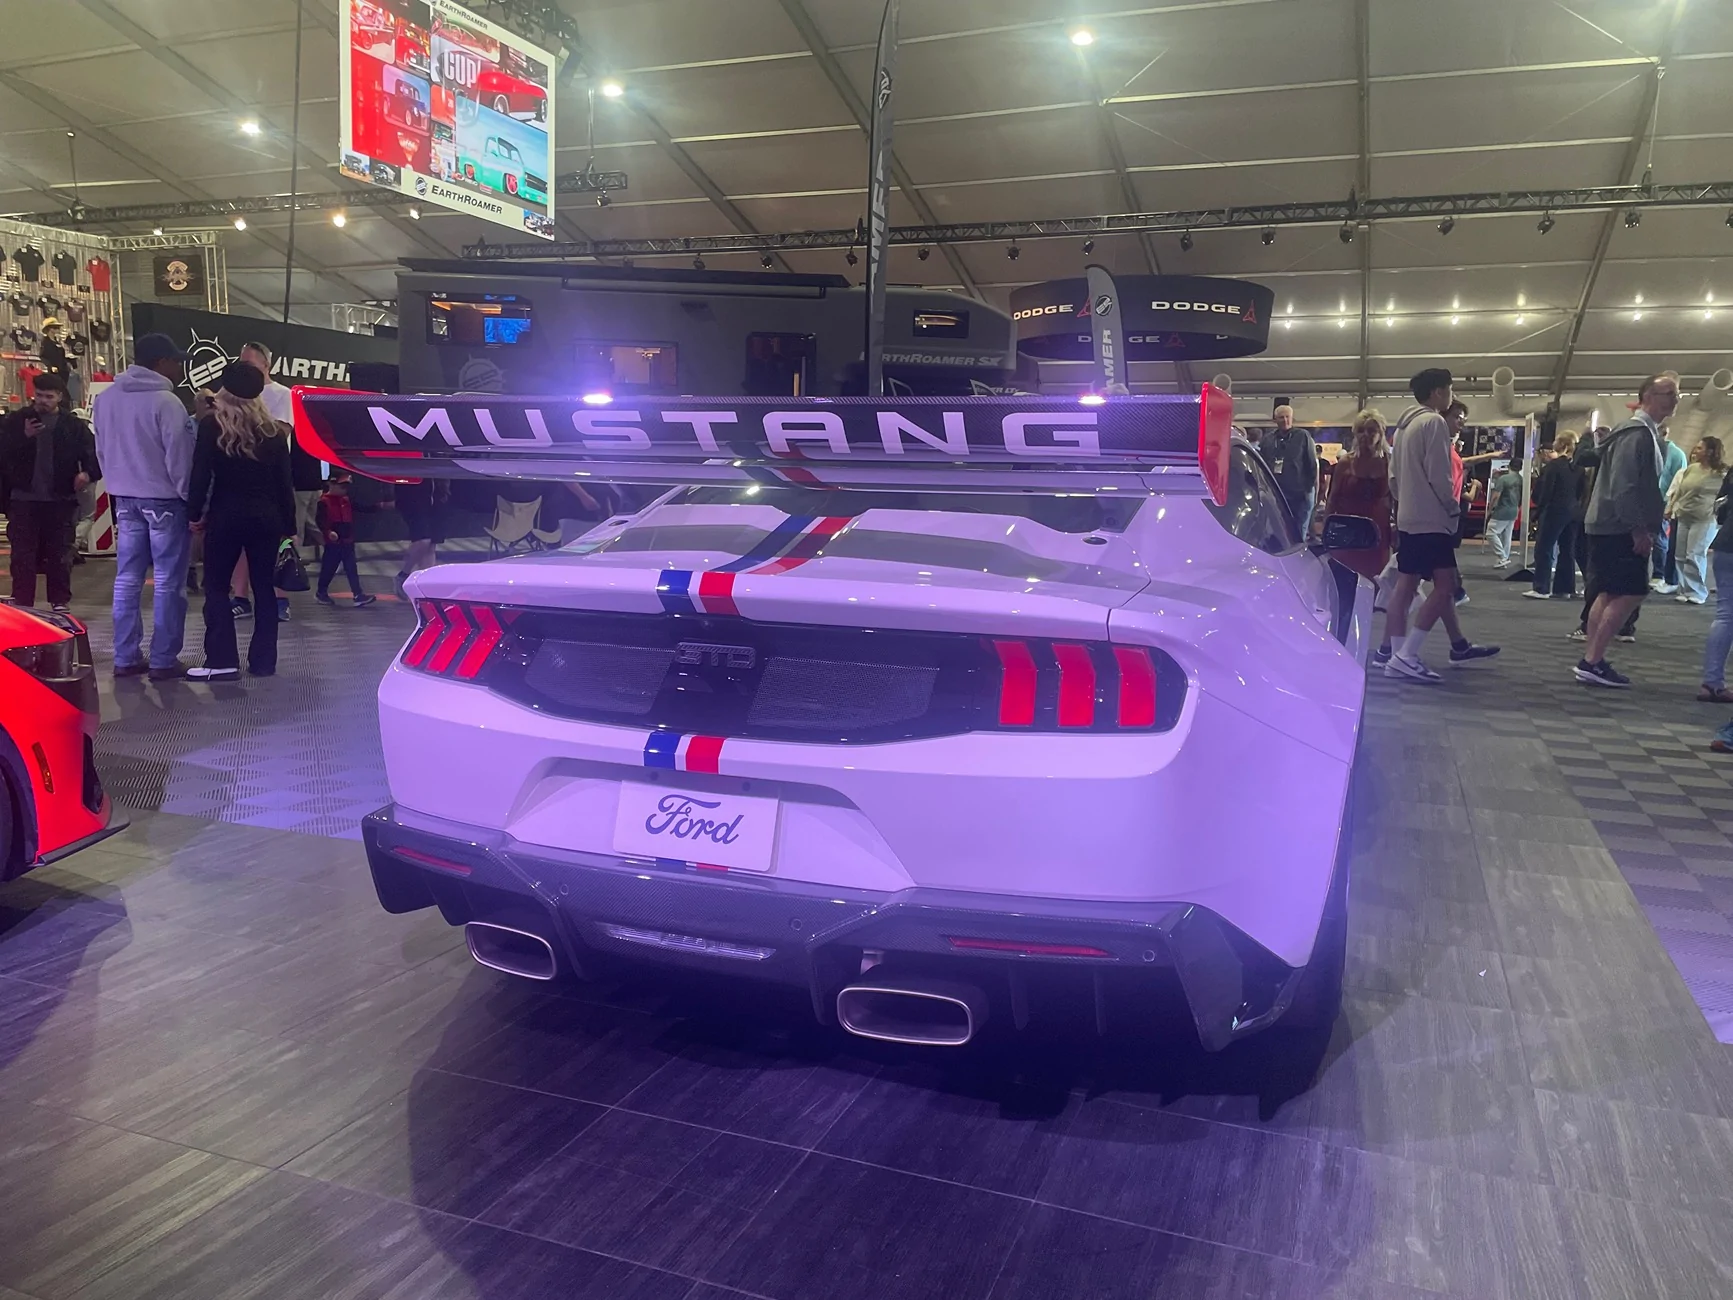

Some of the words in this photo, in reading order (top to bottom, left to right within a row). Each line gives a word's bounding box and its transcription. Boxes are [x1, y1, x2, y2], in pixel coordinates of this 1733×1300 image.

[431, 184, 503, 214] EARTHROAMER
[1013, 304, 1073, 321] DODGE
[1151, 301, 1241, 315] DODGE
[367, 406, 1101, 457] MUSTANG
[645, 794, 745, 845] Ford
